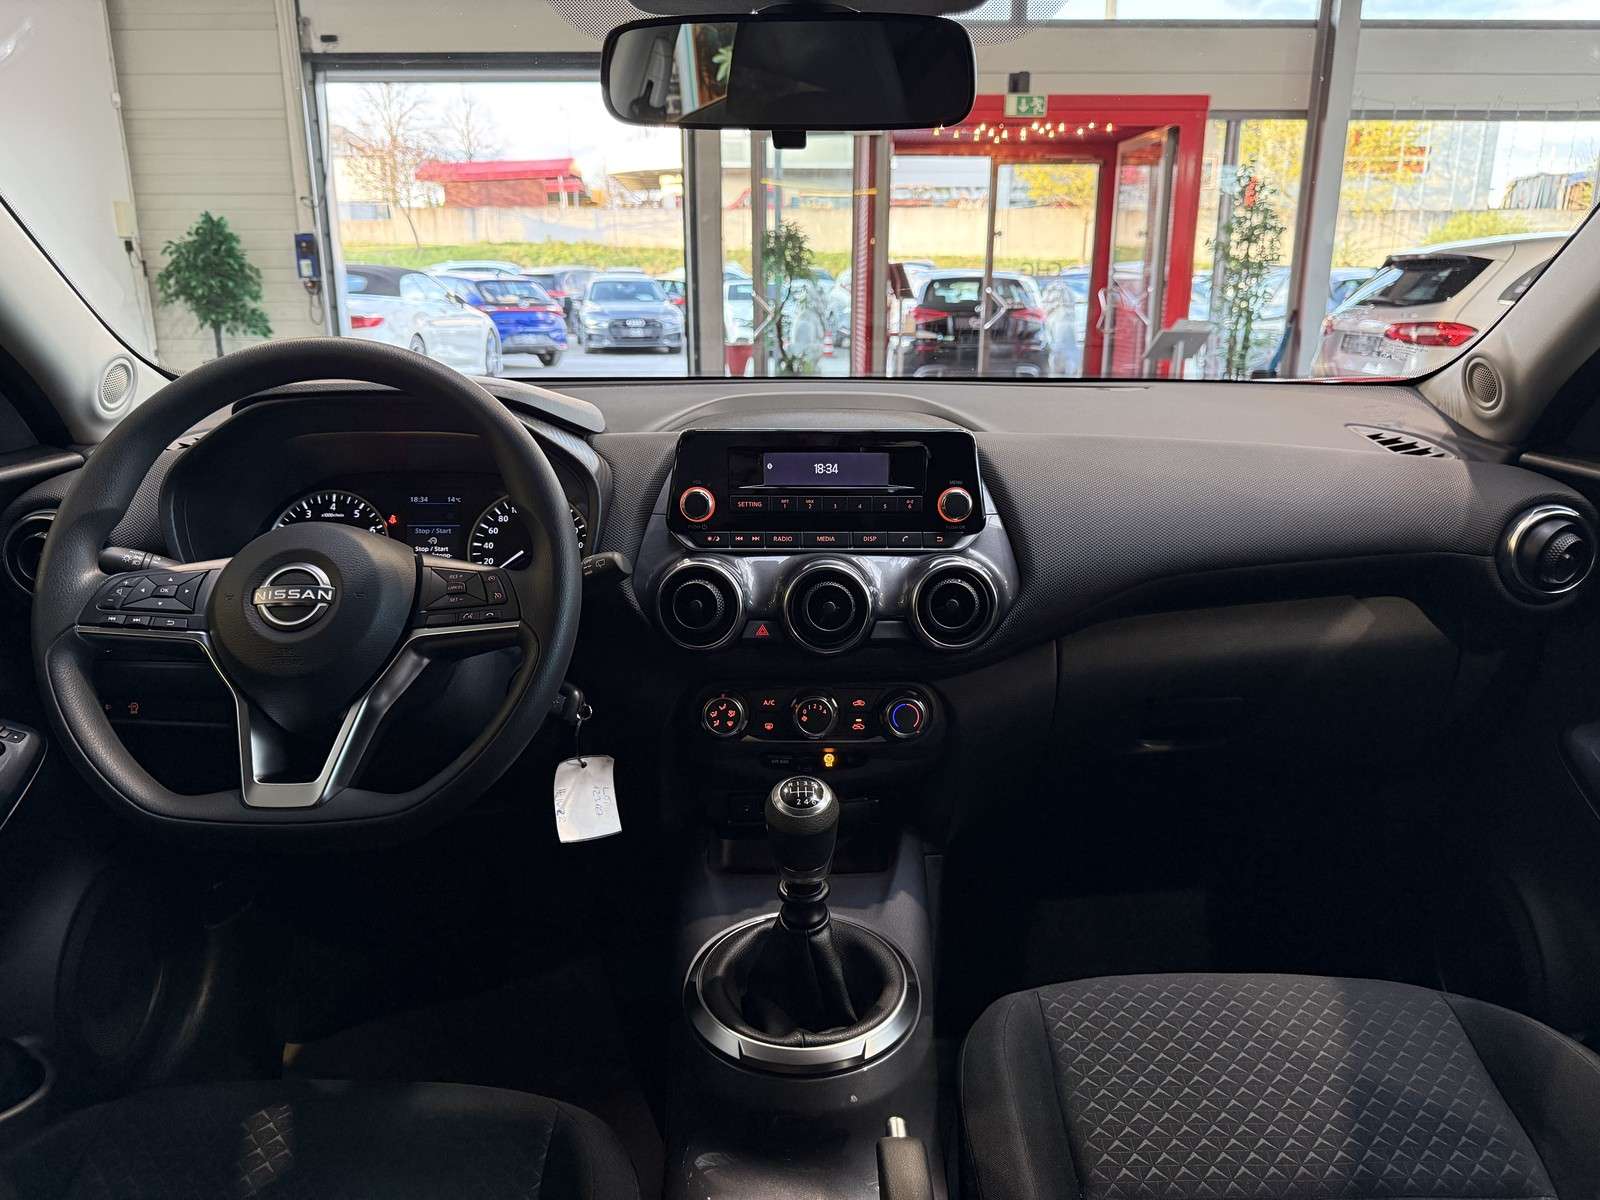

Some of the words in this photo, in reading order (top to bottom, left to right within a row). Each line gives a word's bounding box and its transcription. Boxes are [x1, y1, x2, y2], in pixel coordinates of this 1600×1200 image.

[813, 463, 839, 475] 18:34
[329, 503, 336, 511] 4
[305, 509, 312, 519] 3
[353, 509, 360, 518] 5
[498, 515, 509, 523] 80
[415, 527, 431, 535] Stop
[488, 527, 499, 535] 60
[414, 545, 430, 553] Stop
[482, 542, 494, 550] 40
[483, 557, 494, 566] 20
[255, 589, 333, 601] NISSAN
